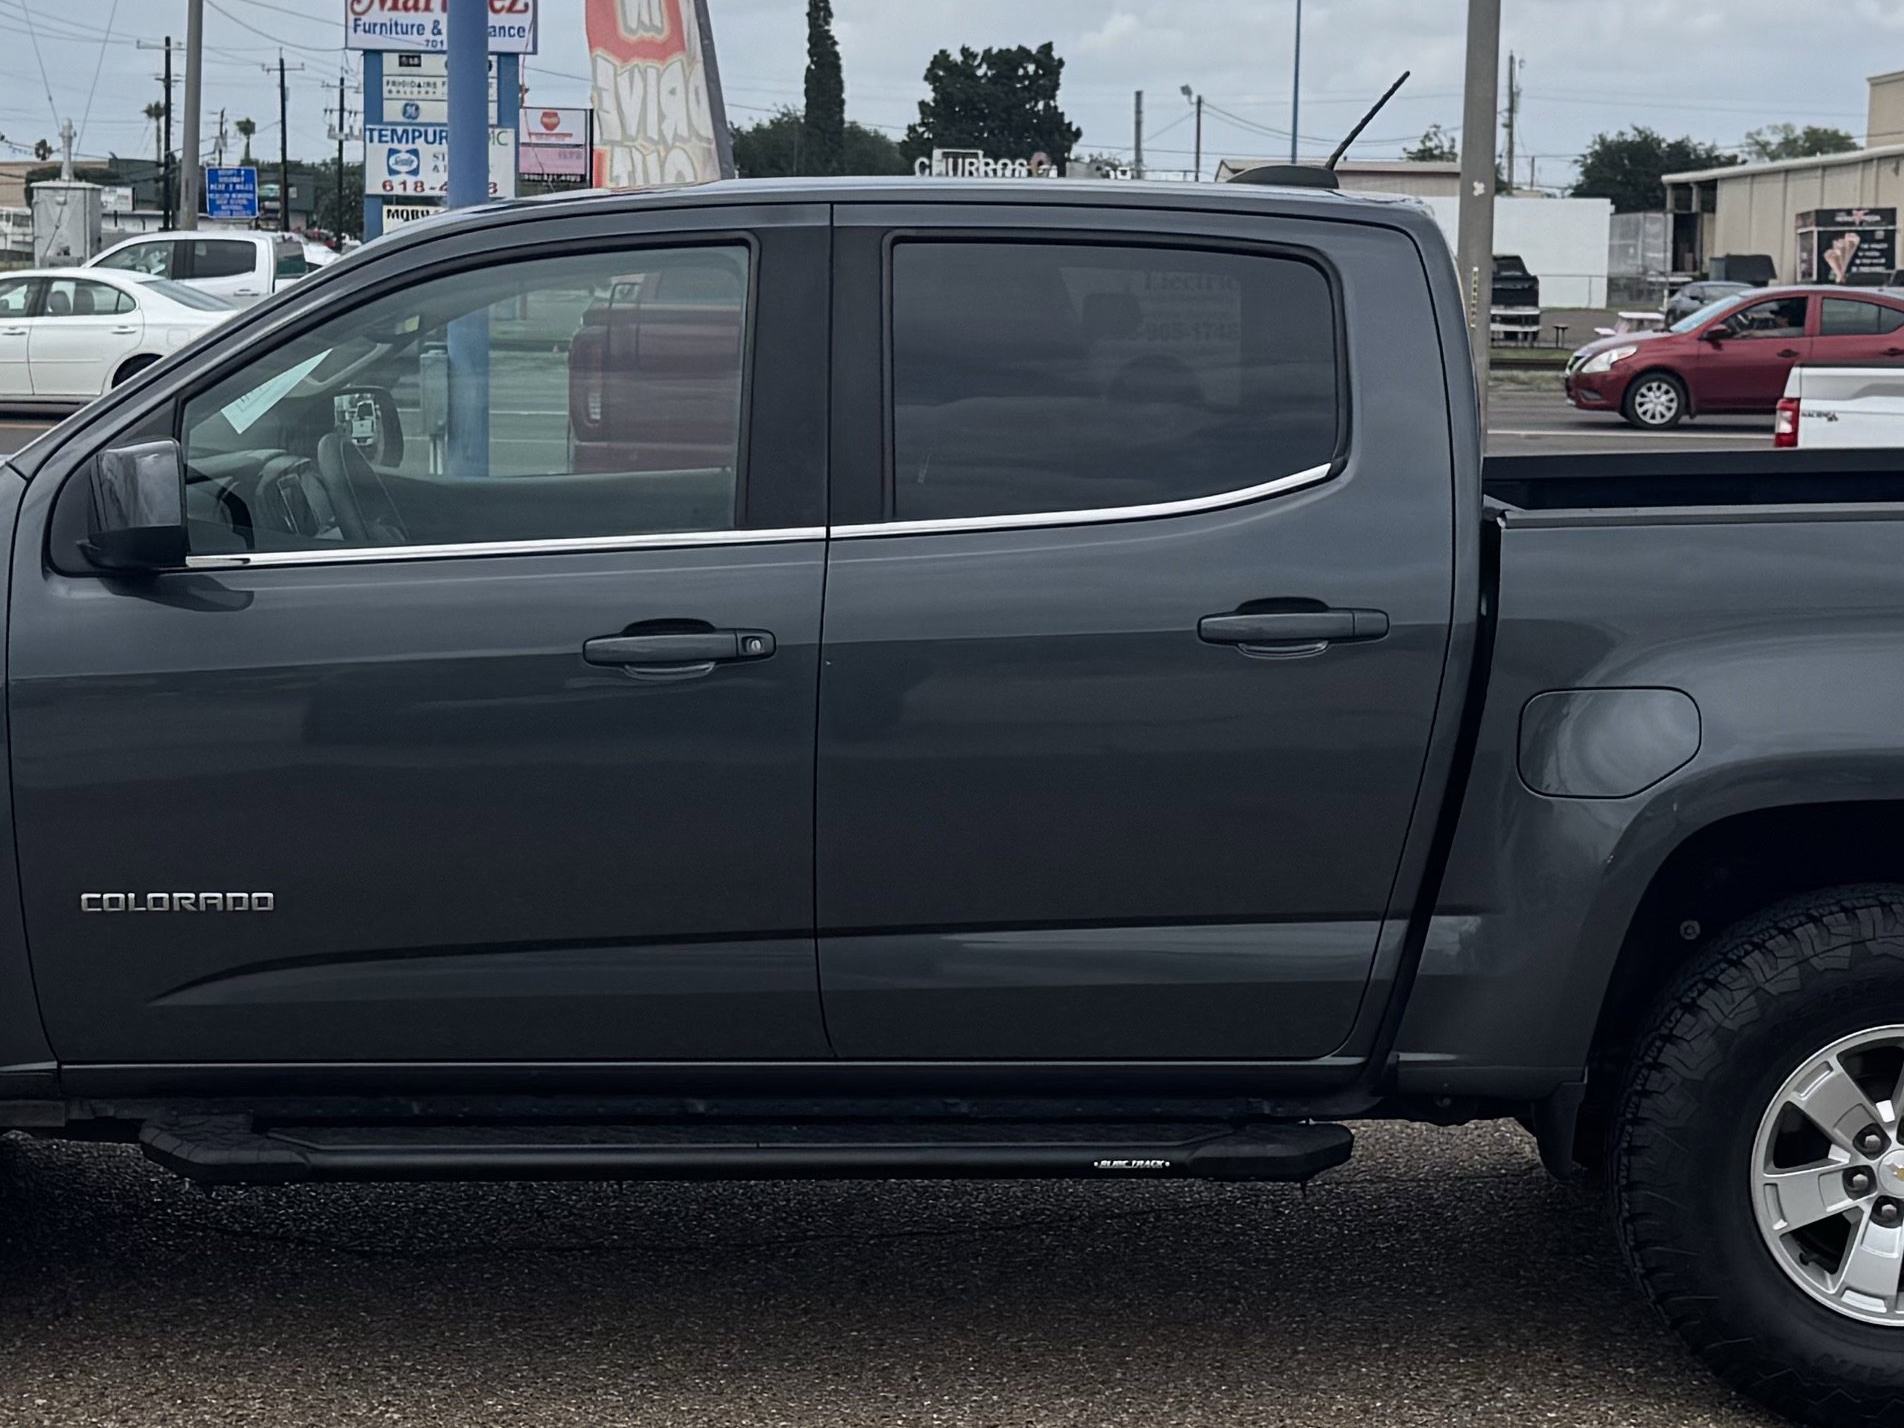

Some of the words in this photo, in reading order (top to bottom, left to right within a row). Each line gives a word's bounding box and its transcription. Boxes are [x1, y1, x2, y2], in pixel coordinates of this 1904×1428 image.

[353, 18, 425, 36] Furniture
[431, 19, 443, 36] &
[80, 892, 275, 912] COLORADO
